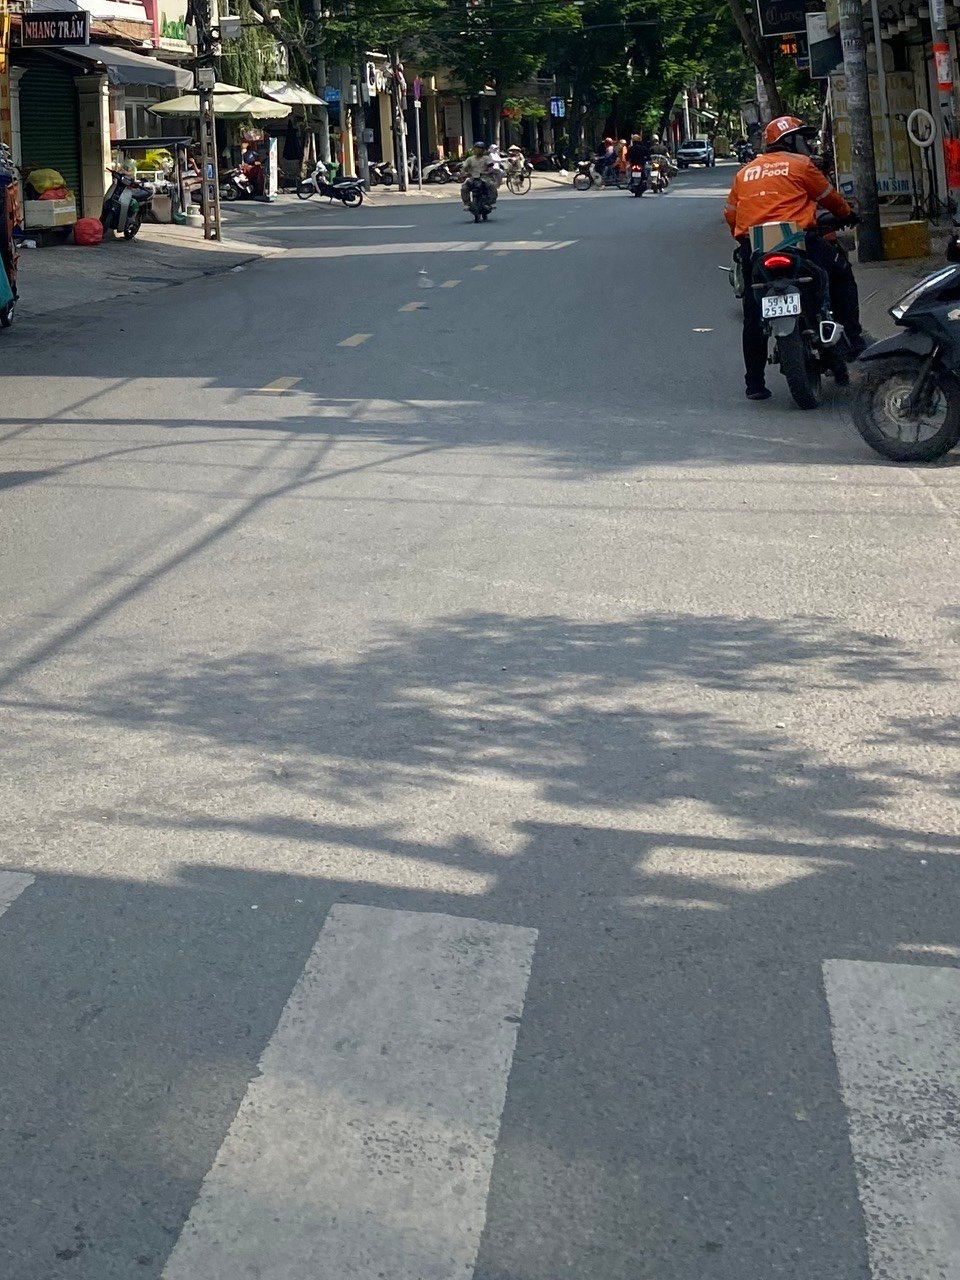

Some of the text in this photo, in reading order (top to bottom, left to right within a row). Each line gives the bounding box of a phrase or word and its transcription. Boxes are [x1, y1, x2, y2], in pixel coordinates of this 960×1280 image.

[25, 21, 56, 39] NHANG
[58, 14, 84, 38] TRẦM
[762, 167, 789, 178] Food
